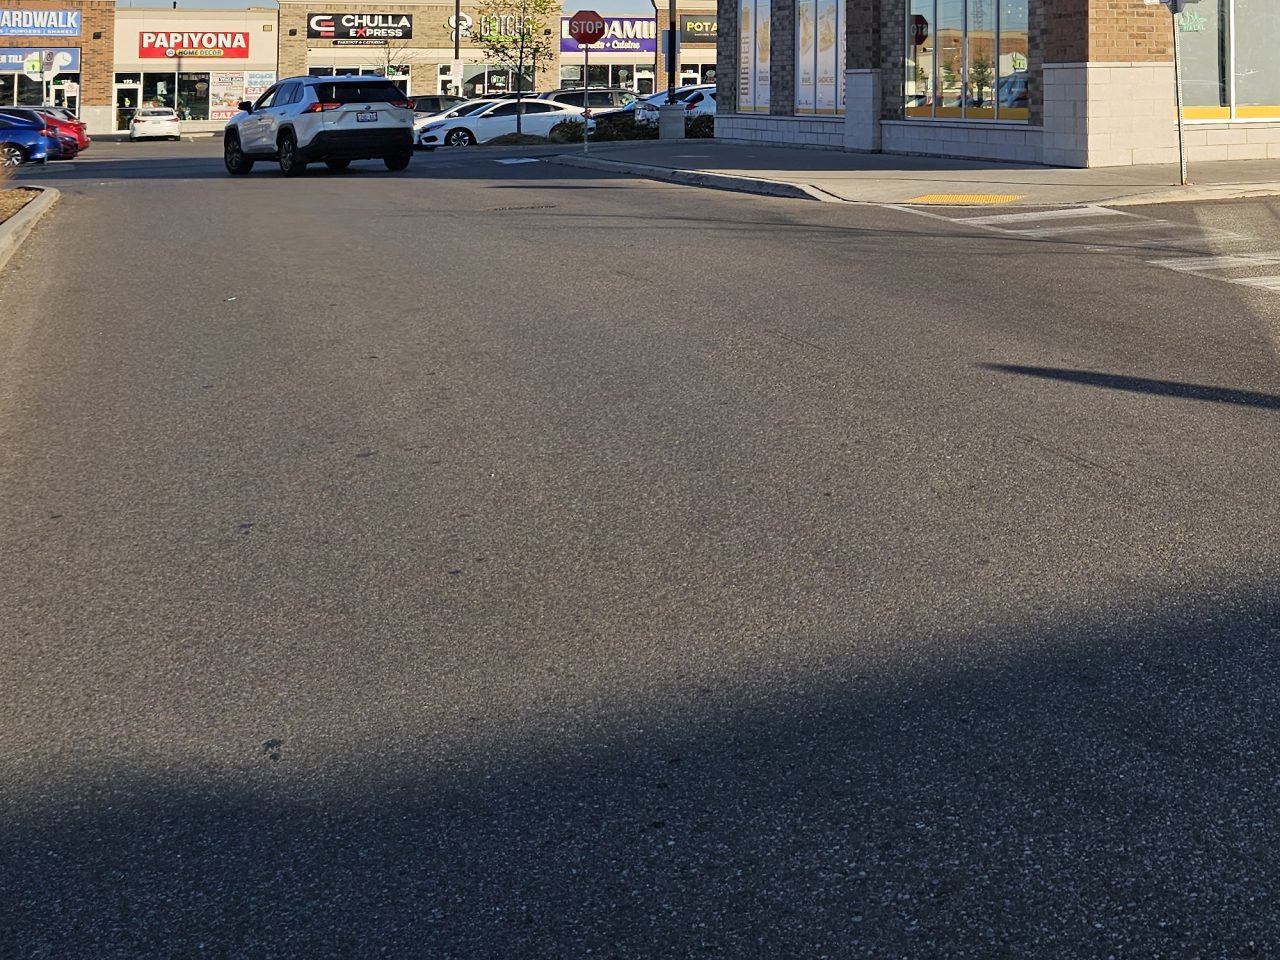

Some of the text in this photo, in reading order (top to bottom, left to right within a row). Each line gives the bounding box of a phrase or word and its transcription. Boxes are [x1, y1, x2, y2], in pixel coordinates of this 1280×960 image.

[341, 15, 411, 28] CHULLA
[570, 20, 603, 34] STOP
[349, 27, 403, 38] EXPRESS
[142, 33, 247, 48] PAPIYONA
